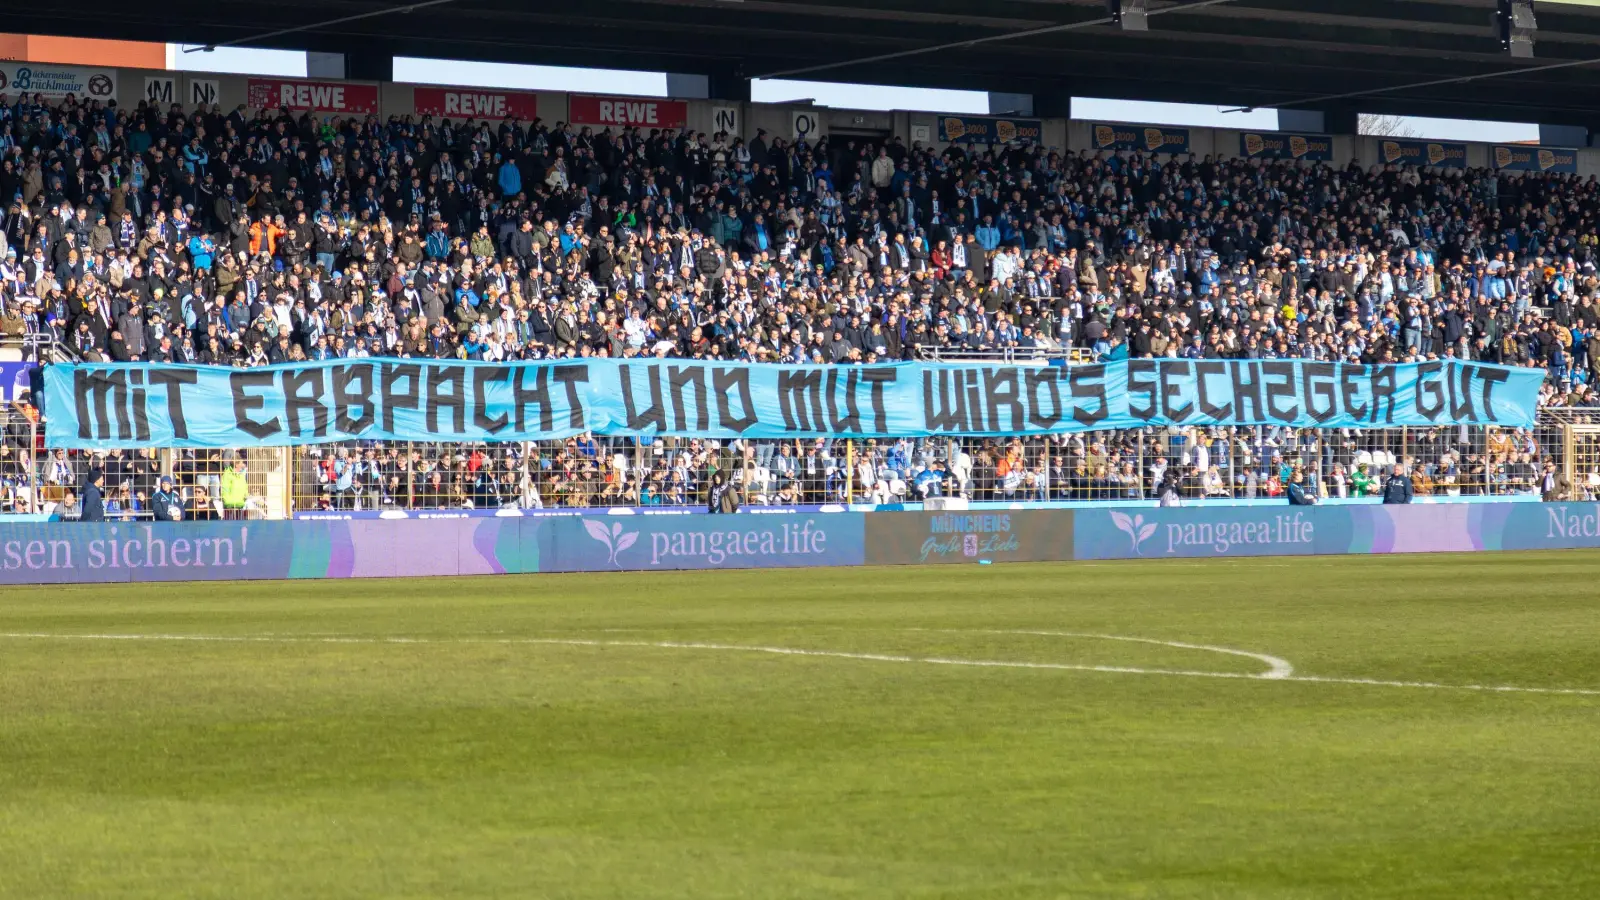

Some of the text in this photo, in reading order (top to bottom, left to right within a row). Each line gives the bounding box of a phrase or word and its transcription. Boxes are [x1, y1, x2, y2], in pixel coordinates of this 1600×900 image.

[153, 80, 173, 103] M
[193, 81, 209, 104] N
[280, 84, 346, 109] REWE
[445, 92, 507, 116] REWE
[600, 101, 659, 124] REWE
[721, 110, 735, 130] N
[229, 363, 590, 440] ERBPACHT
[619, 363, 759, 433] UND
[778, 366, 898, 434] MUT
[1415, 360, 1511, 424] GUT
[931, 512, 1011, 533] MÜNCHENS
[0, 526, 249, 570] sen sichern!
[920, 533, 1020, 563] Große Liebe
